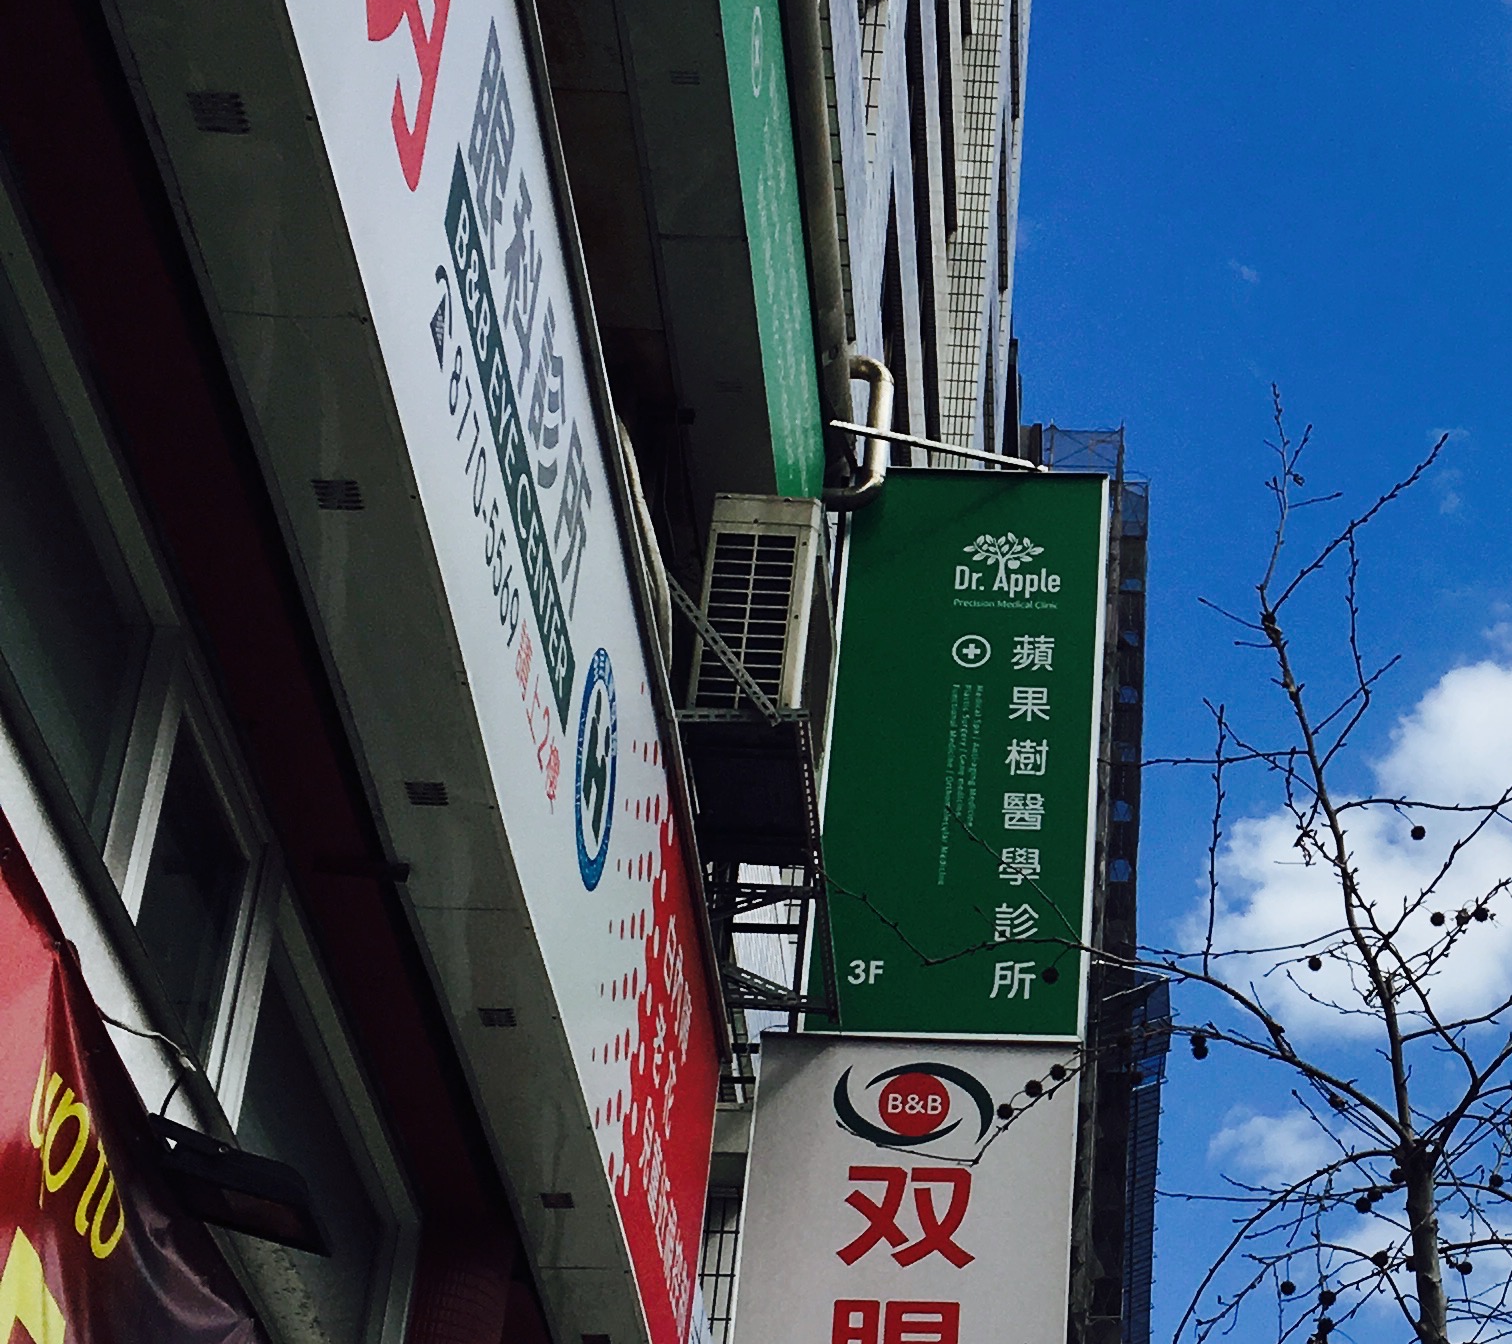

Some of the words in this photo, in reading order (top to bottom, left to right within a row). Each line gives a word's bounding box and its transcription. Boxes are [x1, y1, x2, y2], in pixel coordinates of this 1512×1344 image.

[468, 16, 591, 621] 眼科診所
[449, 346, 521, 649] 8770-5569
[453, 195, 490, 360] B&B
[488, 350, 521, 480] EYE
[516, 480, 568, 704] CENTER
[953, 598, 995, 608] Precision
[997, 599, 1033, 609] Medical
[1034, 600, 1059, 610] Clinic
[954, 565, 985, 591] Dr.
[992, 567, 1061, 599] Apple
[989, 633, 1055, 1002] 蘋果樹醫學診所
[847, 959, 884, 986] 3F
[30, 1064, 90, 1208] up
[74, 1128, 126, 1259] to
[886, 1092, 942, 1115] B&B
